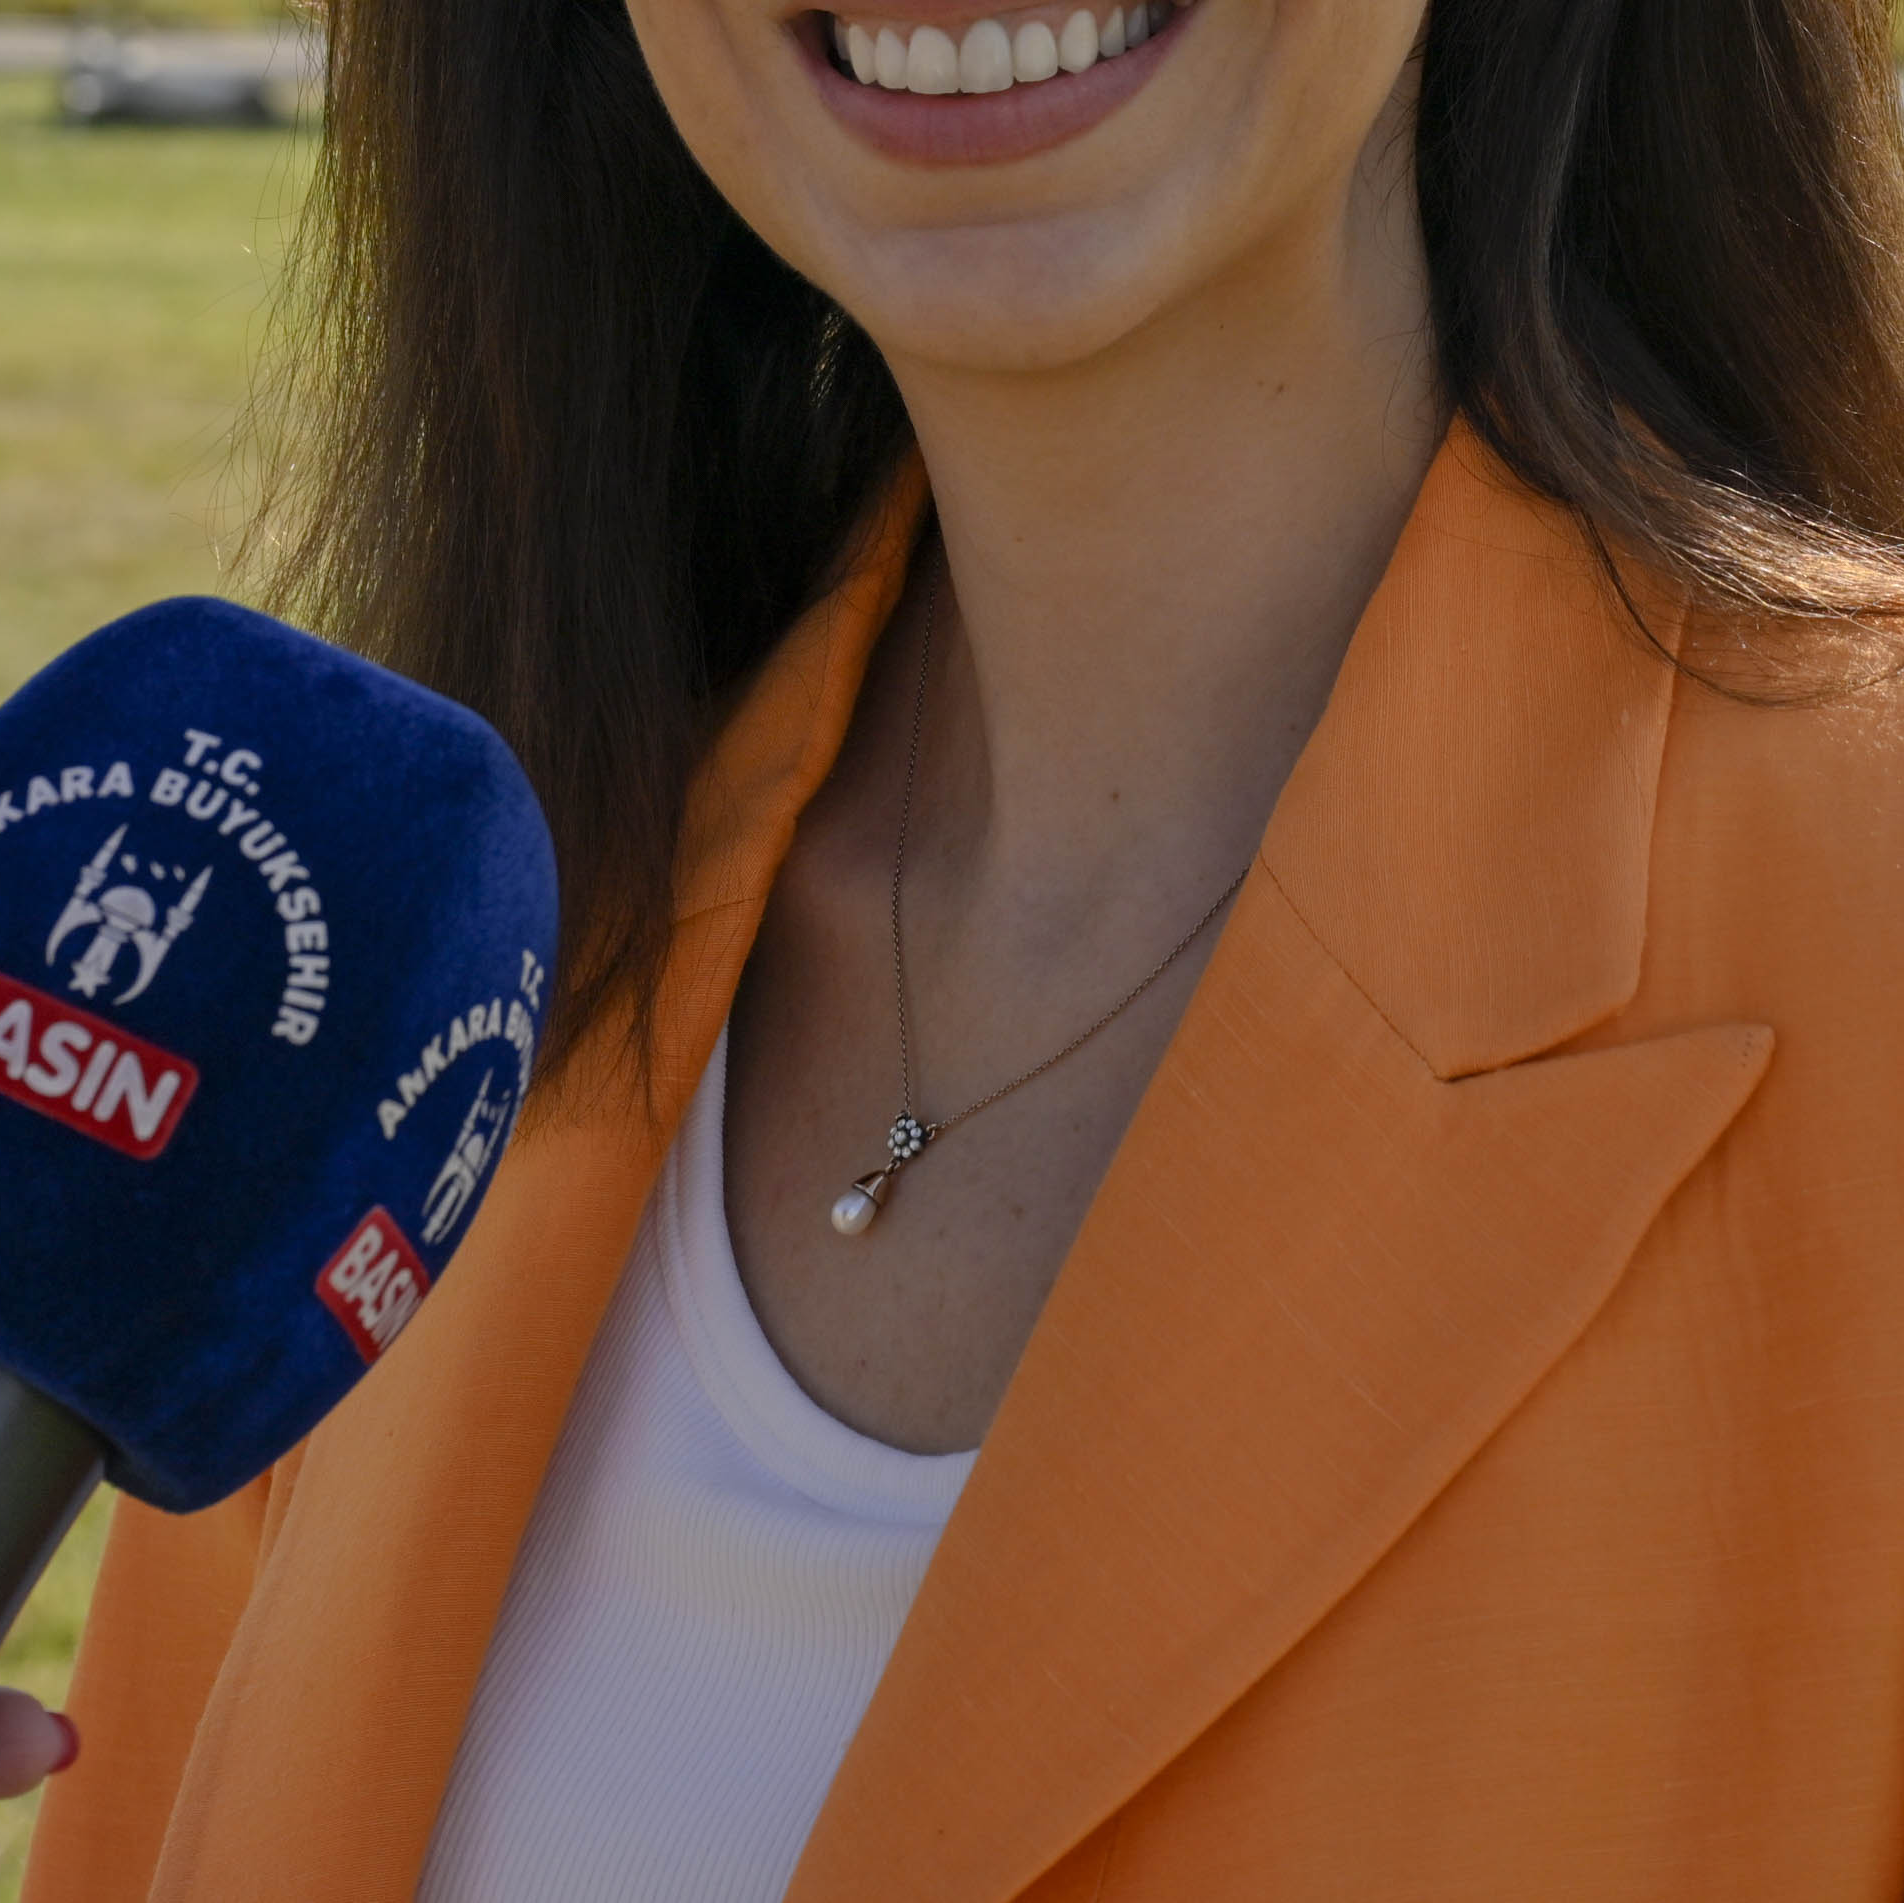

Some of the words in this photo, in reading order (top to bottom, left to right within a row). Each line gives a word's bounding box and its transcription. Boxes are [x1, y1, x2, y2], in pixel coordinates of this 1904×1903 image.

[183, 728, 263, 796] T.C.
[150, 767, 331, 1046] BUYUKSEHIR
[377, 996, 502, 1142] ANKARA
